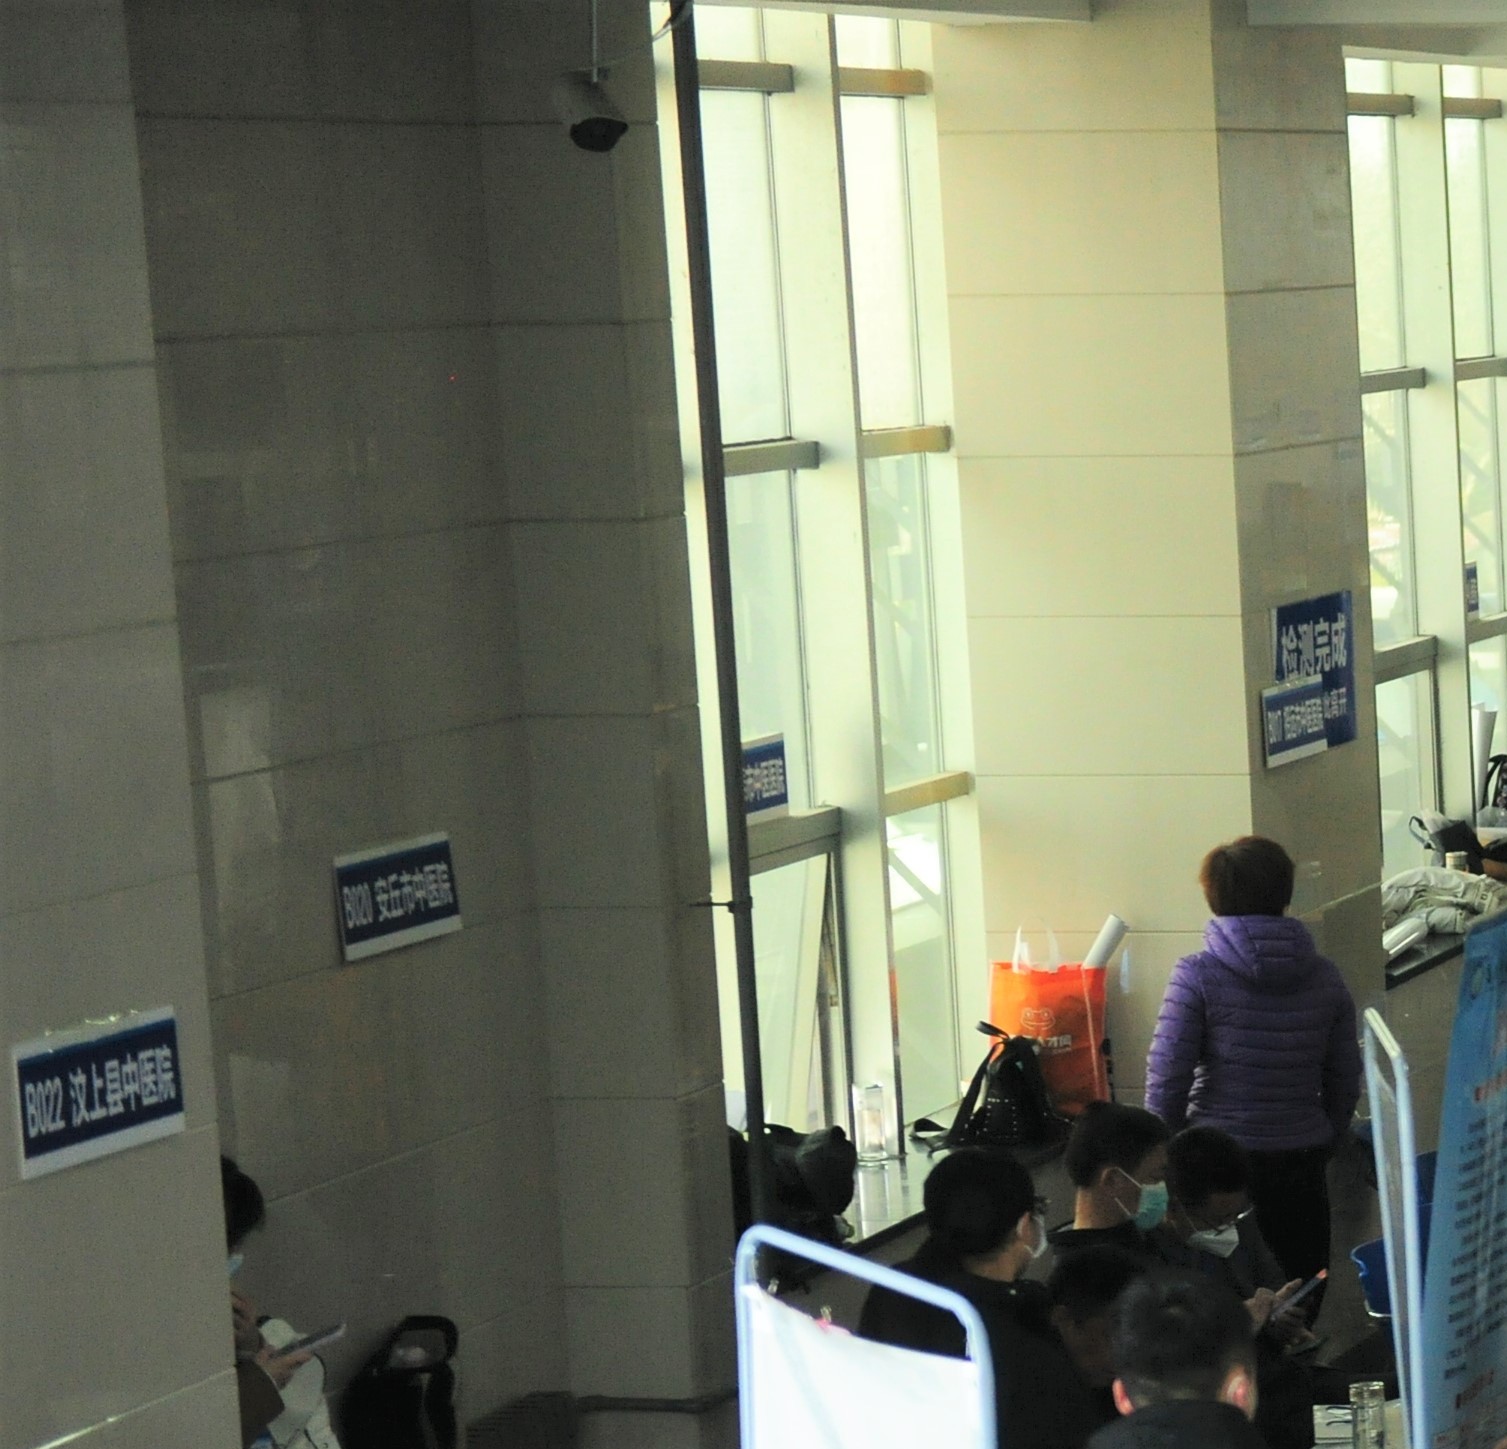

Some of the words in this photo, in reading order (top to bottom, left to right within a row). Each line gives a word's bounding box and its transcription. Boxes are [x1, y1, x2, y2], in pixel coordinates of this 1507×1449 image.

[1282, 612, 1347, 681] 检测完成
[342, 881, 374, 930] B020
[374, 861, 454, 923] 安丘市中医院
[24, 1075, 66, 1138] B022
[68, 1044, 177, 1128] 汶上县中医院
